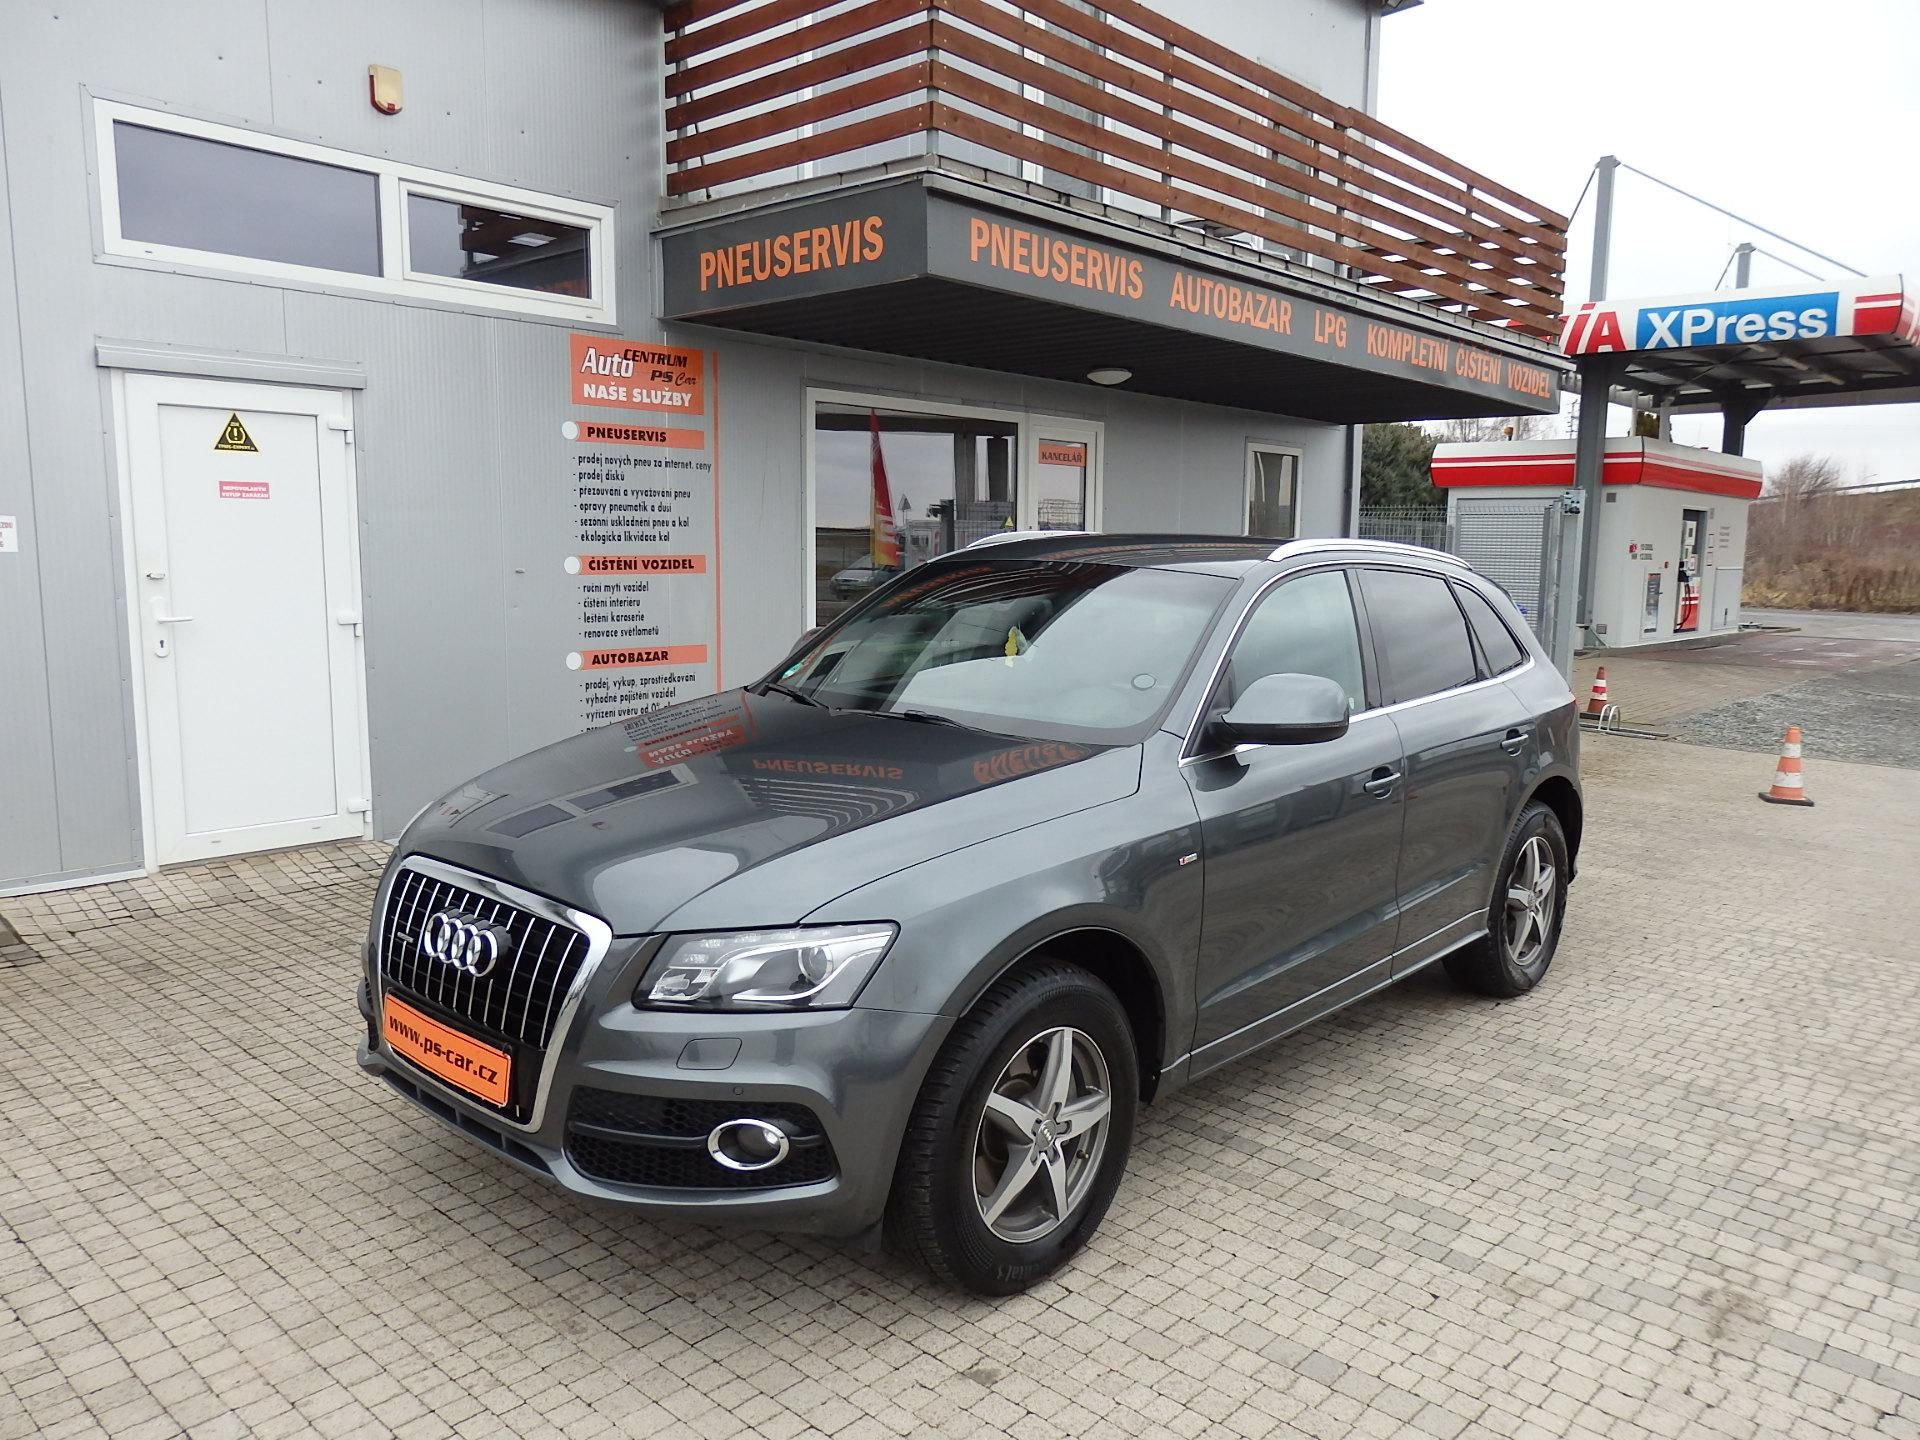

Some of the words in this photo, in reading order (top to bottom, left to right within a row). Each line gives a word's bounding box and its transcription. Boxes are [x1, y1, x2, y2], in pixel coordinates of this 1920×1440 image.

[699, 215, 885, 292] PNEUSERVIS
[969, 217, 1144, 300] PNEUSERVIS
[1170, 271, 1292, 336] AUTOBAZAR
[1314, 309, 1347, 348] LPG
[1367, 322, 1450, 373] KOMPLETNÍ
[1507, 363, 1551, 399] VOZIDEL
[1644, 307, 1828, 350] XPress
[580, 346, 634, 378] Auto
[623, 348, 688, 368] CENTRUM
[650, 369, 674, 383] PS
[674, 372, 696, 387] Car
[583, 381, 627, 402] NAŠE
[632, 387, 692, 407] SLUŽBY
[587, 426, 668, 443] PNEUSERVIS
[578, 453, 603, 466] prodej
[604, 454, 632, 469] nových
[634, 458, 652, 469] pneu
[653, 460, 663, 468] za
[695, 461, 712, 473] ceny
[578, 469, 603, 483] prodej
[623, 488, 628, 497] a
[674, 490, 691, 501] pneu
[579, 502, 607, 514] opravy
[609, 501, 648, 514] pneumatik
[651, 504, 656, 512] a
[652, 519, 669, 529] pneu
[672, 519, 676, 528] a
[678, 517, 690, 528] kol
[624, 531, 657, 542] likvidace
[659, 531, 670, 543] kol
[588, 556, 637, 571] ČIŠTĚNÍ
[641, 559, 695, 571] VOZIDEL
[623, 581, 649, 592] vozidel
[610, 611, 645, 623] karoserie
[584, 629, 619, 639] renovace
[591, 650, 669, 666] AUTOBAZAR
[651, 687, 676, 700] vozidel
[640, 705, 649, 714] od
[389, 1015, 498, 1086] www.ps-car.cz
